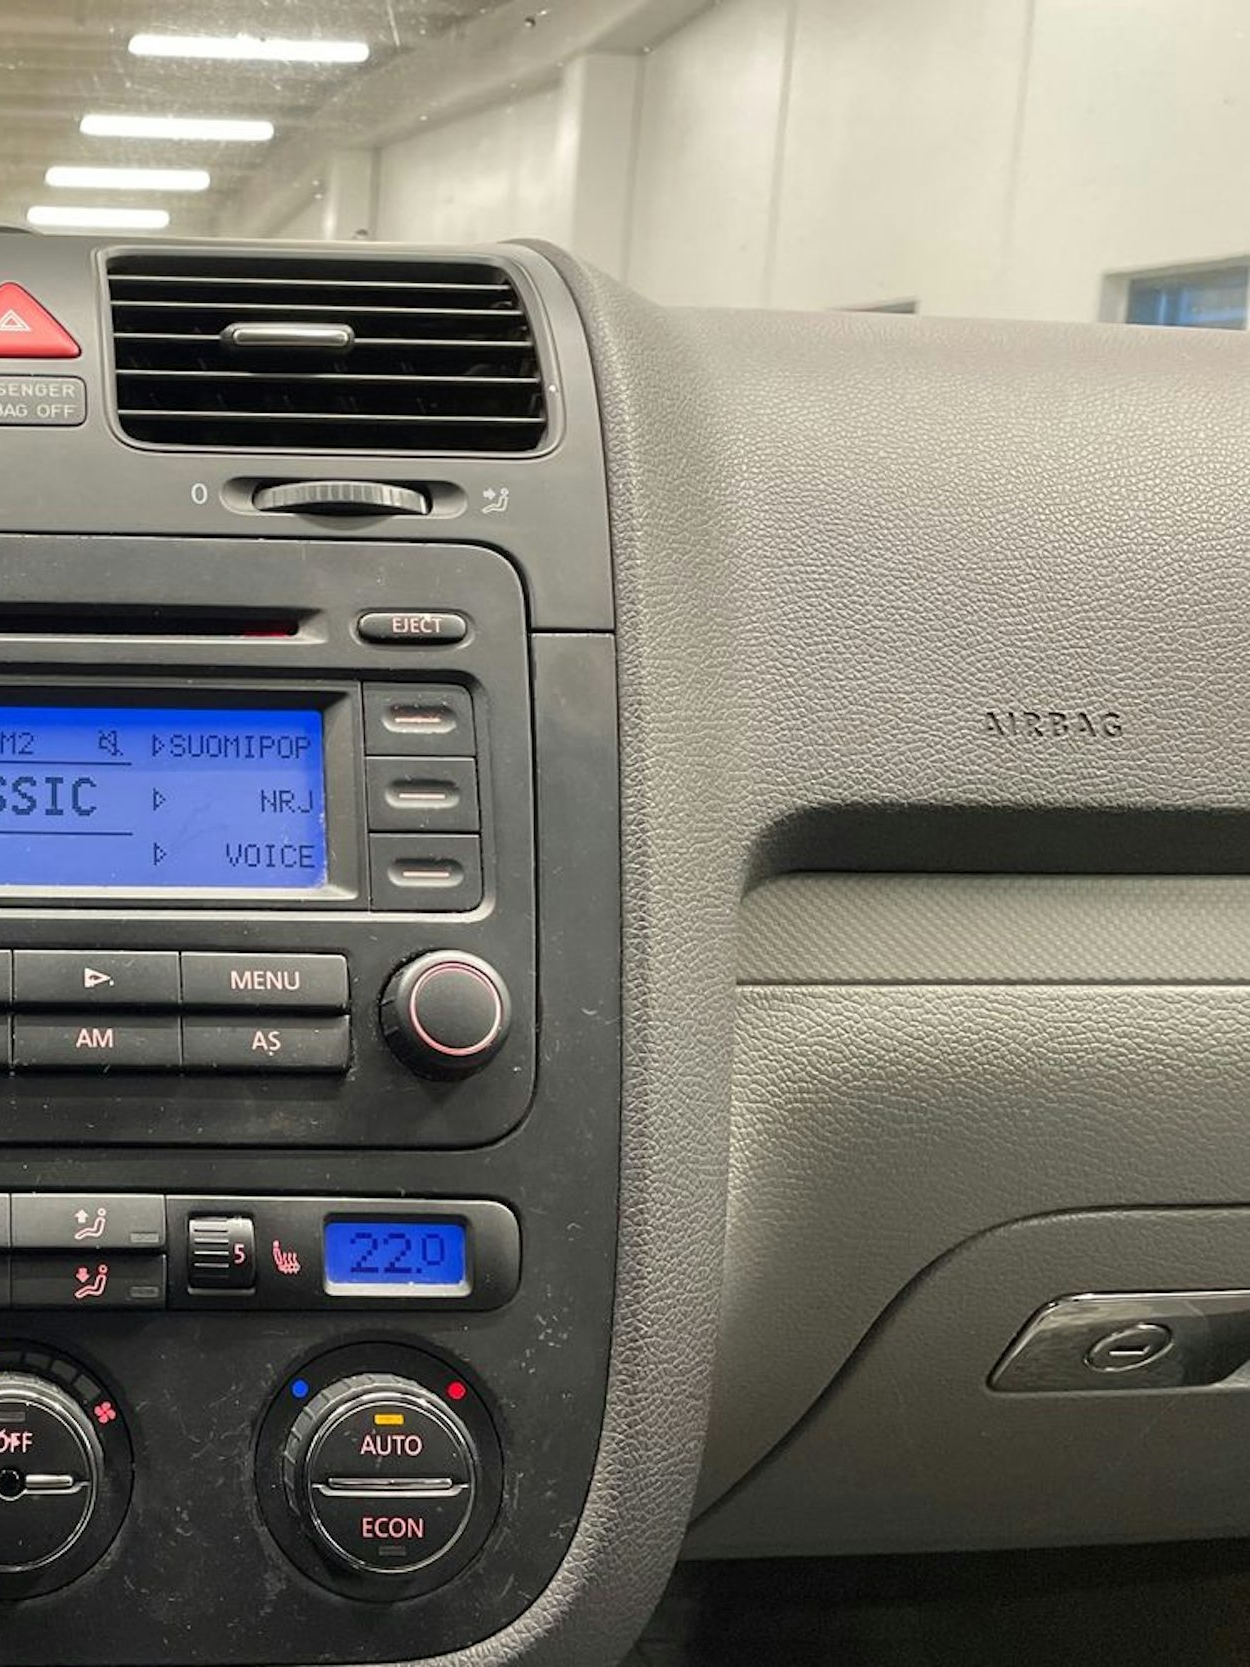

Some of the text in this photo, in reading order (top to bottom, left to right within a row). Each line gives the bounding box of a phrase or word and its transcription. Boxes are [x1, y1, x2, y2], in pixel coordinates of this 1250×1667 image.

[36, 404, 77, 418] OFF
[392, 617, 443, 634] EJECT
[986, 711, 1123, 737] AIRBAG
[169, 734, 311, 759] SUOMIPOP
[260, 789, 314, 813] NRJ
[225, 843, 316, 868] VOICE
[230, 970, 301, 990] MENU
[75, 1028, 114, 1048] AM
[251, 1031, 281, 1051] AS
[234, 1243, 246, 1264] 5
[360, 1434, 423, 1457] AUTO
[361, 1516, 425, 1540] ECON
